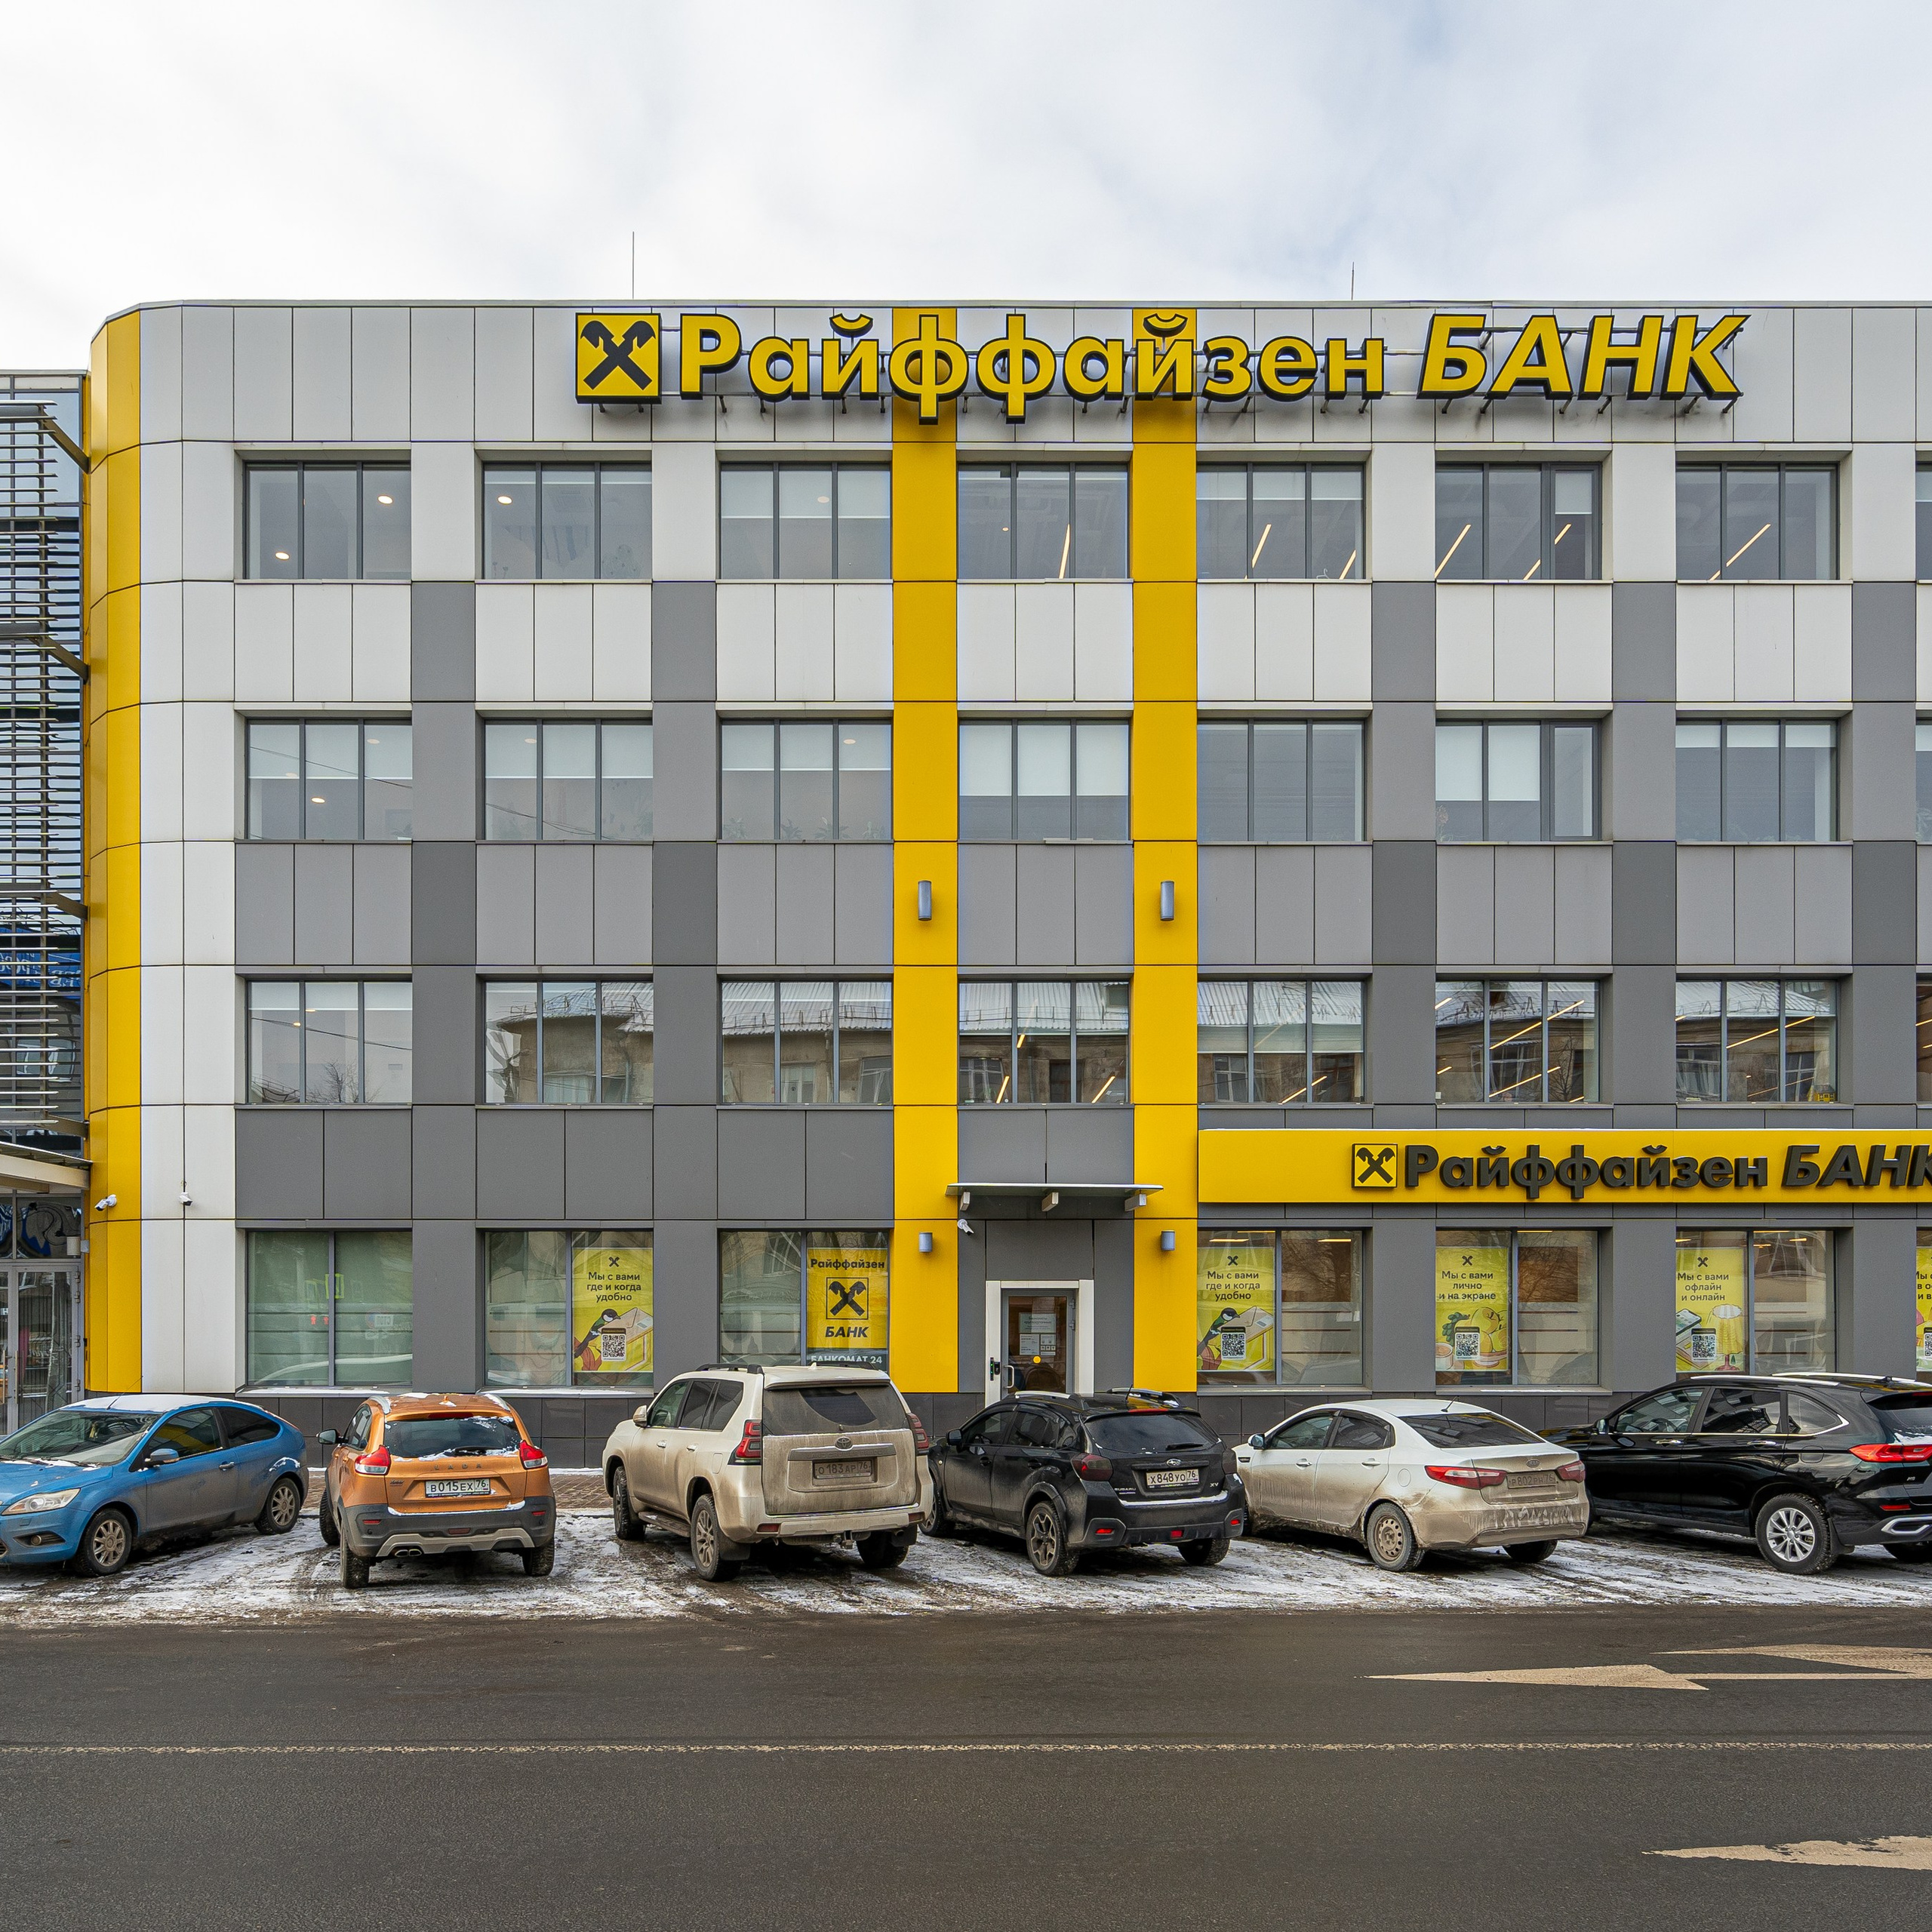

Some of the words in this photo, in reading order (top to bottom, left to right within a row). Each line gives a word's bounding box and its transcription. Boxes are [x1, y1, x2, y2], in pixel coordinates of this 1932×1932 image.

[679, 312, 1385, 425] Райффайзен
[1416, 314, 1752, 400] БАНК
[1404, 1144, 1767, 1199] Райффайзен
[811, 1259, 885, 1270] Райффайзен
[588, 1272, 605, 1281] Мы
[1208, 1271, 1224, 1279] Мы
[1441, 1270, 1459, 1279] Мы
[1677, 1272, 1694, 1281] Мы
[1684, 1283, 1722, 1293] офлайн
[596, 1292, 632, 1303] удобно
[1215, 1291, 1251, 1302] удобно
[1461, 1293, 1497, 1302] экране
[1690, 1293, 1725, 1301] онлайн
[825, 1326, 869, 1338] БАНК
[870, 1355, 882, 1364] 24
[1187, 1470, 1196, 1478] 76
[475, 1479, 486, 1487] 76
